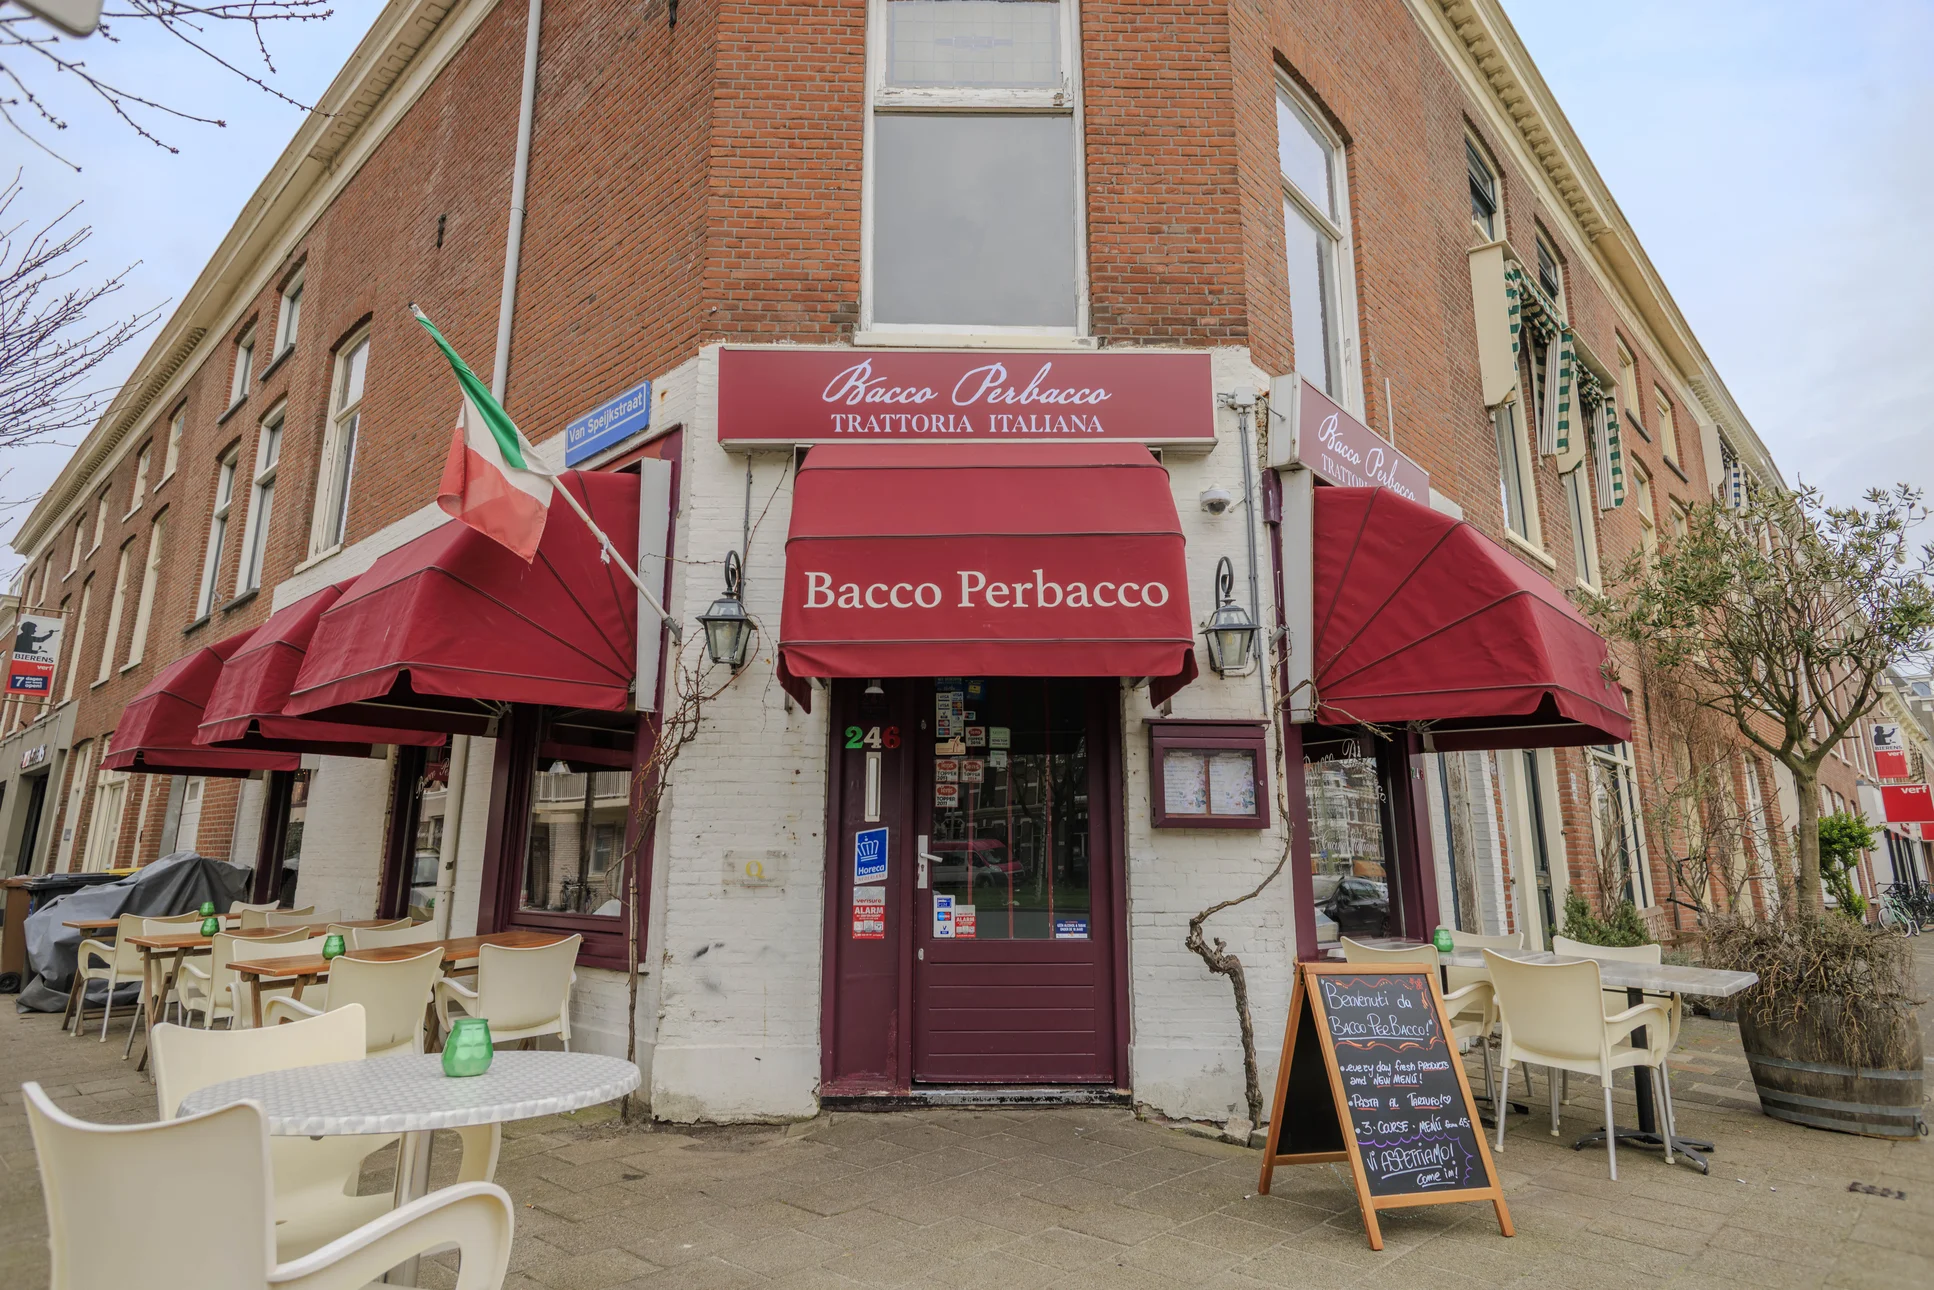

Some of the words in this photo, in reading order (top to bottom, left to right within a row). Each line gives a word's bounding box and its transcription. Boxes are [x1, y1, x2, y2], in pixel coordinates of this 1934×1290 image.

[822, 358, 938, 406] Bacco
[952, 361, 1111, 407] Perbacco
[569, 426, 585, 443] Van
[587, 392, 643, 433] Speijkstraat
[831, 413, 973, 433] TRATTORIA
[989, 413, 1104, 433] ITALIANA
[1318, 412, 1361, 465] Bacco
[1365, 448, 1416, 501] Perbacco
[803, 572, 942, 609] Bacco
[957, 569, 1169, 608] Perbacco
[14, 653, 54, 663] BIERENS
[15, 676, 25, 687] 7
[845, 725, 901, 749] 246
[1900, 785, 1928, 794] verf
[745, 860, 766, 879] Q
[858, 864, 885, 876] Horeca
[854, 907, 884, 915] ALARM
[1397, 994, 1412, 1009] da
[1346, 1064, 1374, 1077] every
[1376, 1061, 1392, 1076] day
[1395, 1060, 1416, 1073] fresh
[1373, 1077, 1391, 1086] NEW
[1352, 1093, 1379, 1108] PASTA
[1389, 1098, 1399, 1108] AL
